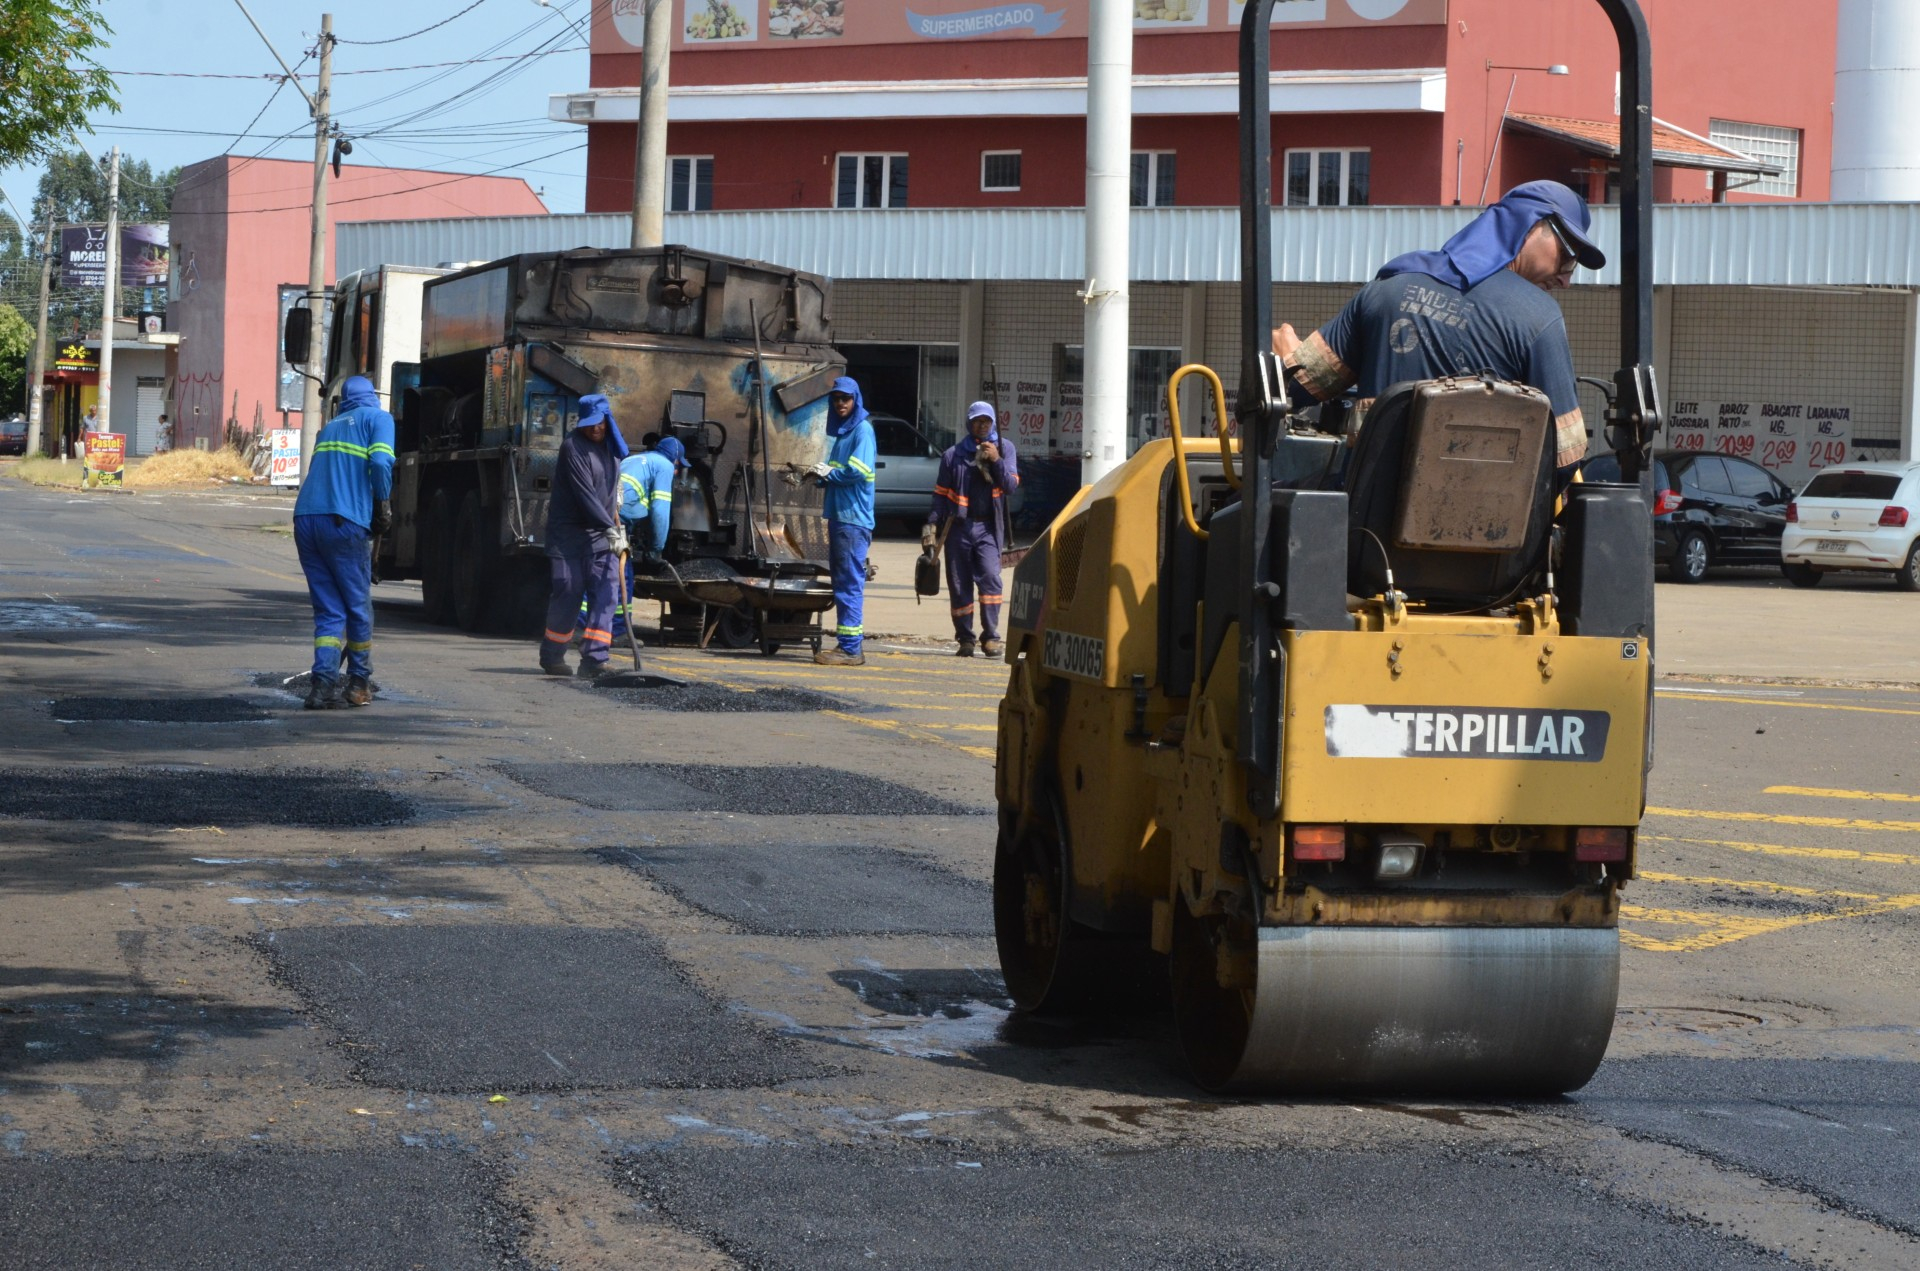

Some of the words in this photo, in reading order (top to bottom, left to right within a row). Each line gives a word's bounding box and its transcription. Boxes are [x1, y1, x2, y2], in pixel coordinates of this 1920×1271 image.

[921, 8, 1034, 35] SUPERMERCADO
[1017, 381, 1047, 393] CERVEJA
[1675, 402, 1699, 415] LEITE
[1719, 403, 1750, 416] ARROZ
[1761, 404, 1803, 418] ABACATE
[1807, 405, 1850, 421] LARANJA
[1019, 413, 1045, 436] 3,09
[1062, 411, 1083, 433] 2,2
[1669, 416, 1709, 429] JUSSARA
[1718, 416, 1741, 429] PATO
[91, 437, 120, 449] Pastel
[280, 435, 288, 449] 3
[1762, 440, 1797, 469] 2,69
[1011, 580, 1031, 620] CAT
[1044, 630, 1062, 668] RC
[1064, 634, 1103, 678] 30065
[1378, 711, 1585, 755] TERPILLAR
